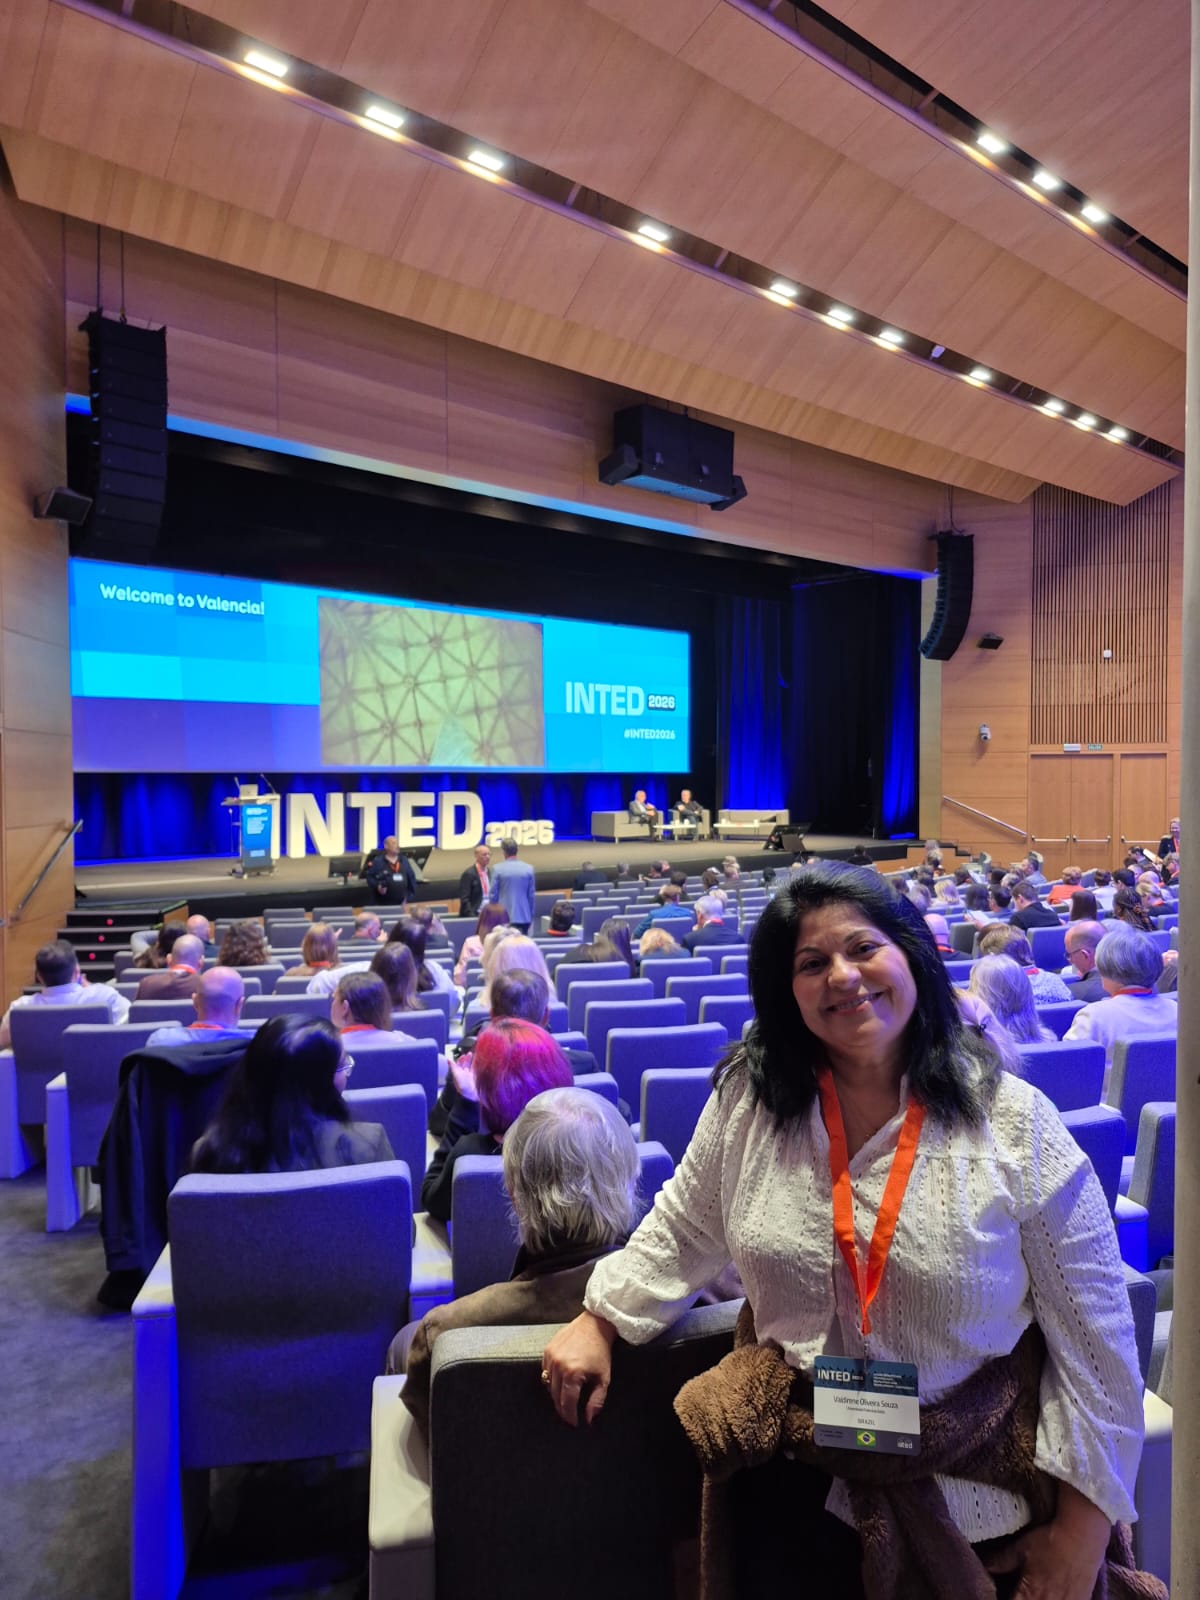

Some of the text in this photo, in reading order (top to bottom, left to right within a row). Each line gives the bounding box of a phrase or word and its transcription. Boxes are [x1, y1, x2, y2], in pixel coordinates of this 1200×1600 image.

[100, 583, 265, 616] Welcome to Valencia!
[565, 681, 675, 716] INTED 2026
[624, 728, 676, 740] #INTED2026
[266, 791, 555, 859] INTED 2026
[817, 1368, 851, 1382] INTED
[880, 1400, 899, 1409] Souza
